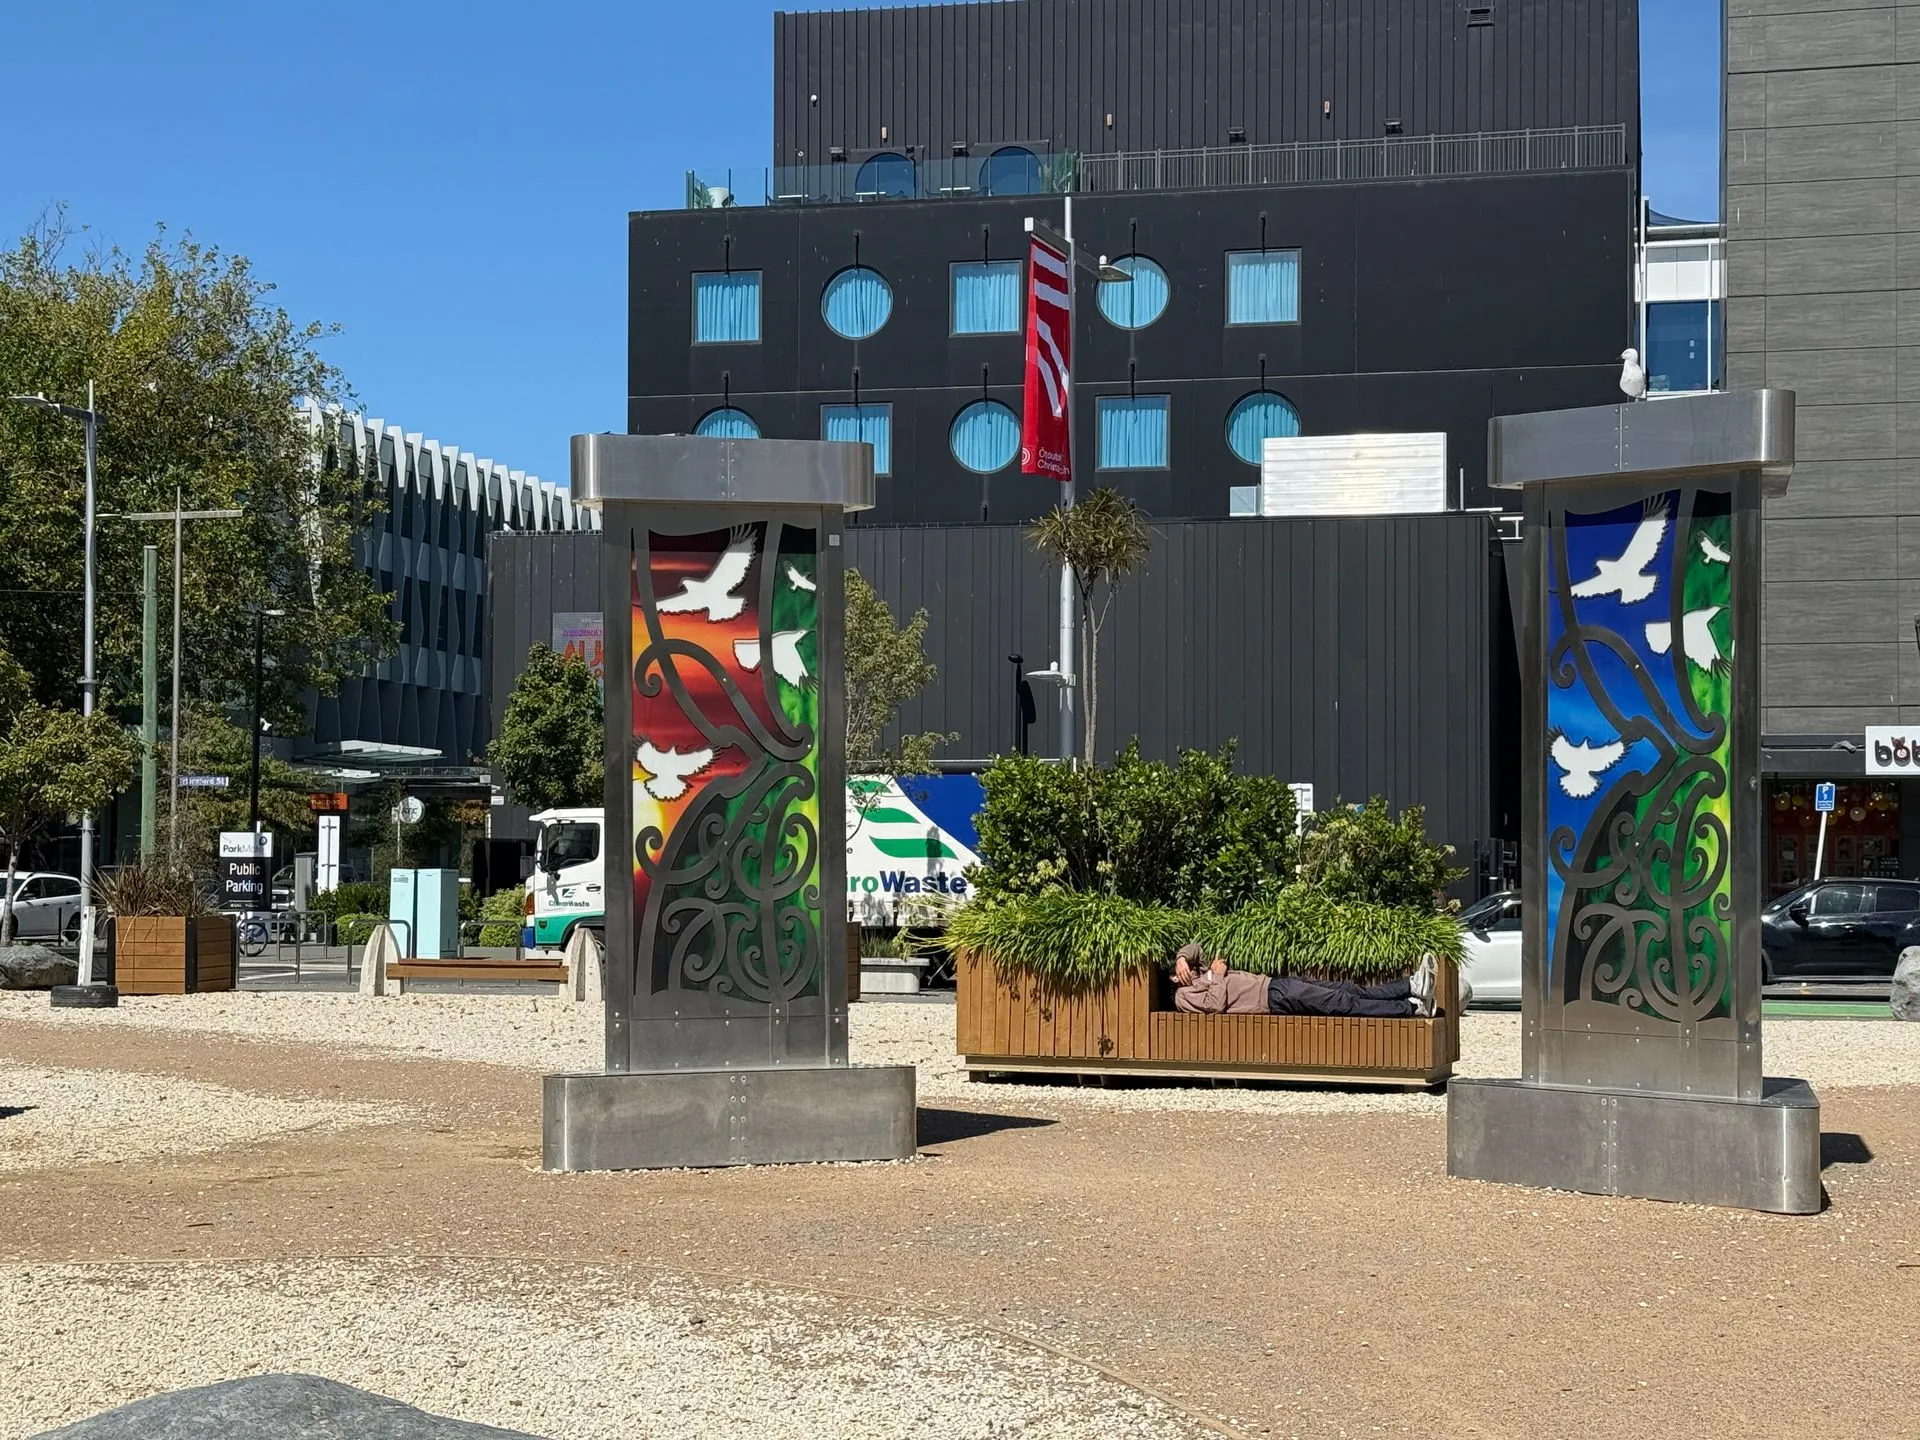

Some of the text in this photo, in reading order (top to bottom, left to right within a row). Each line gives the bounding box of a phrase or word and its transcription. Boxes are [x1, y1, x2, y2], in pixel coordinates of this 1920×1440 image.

[223, 844, 264, 853] ParkMate
[229, 862, 261, 875] Public
[226, 880, 263, 895] Parking
